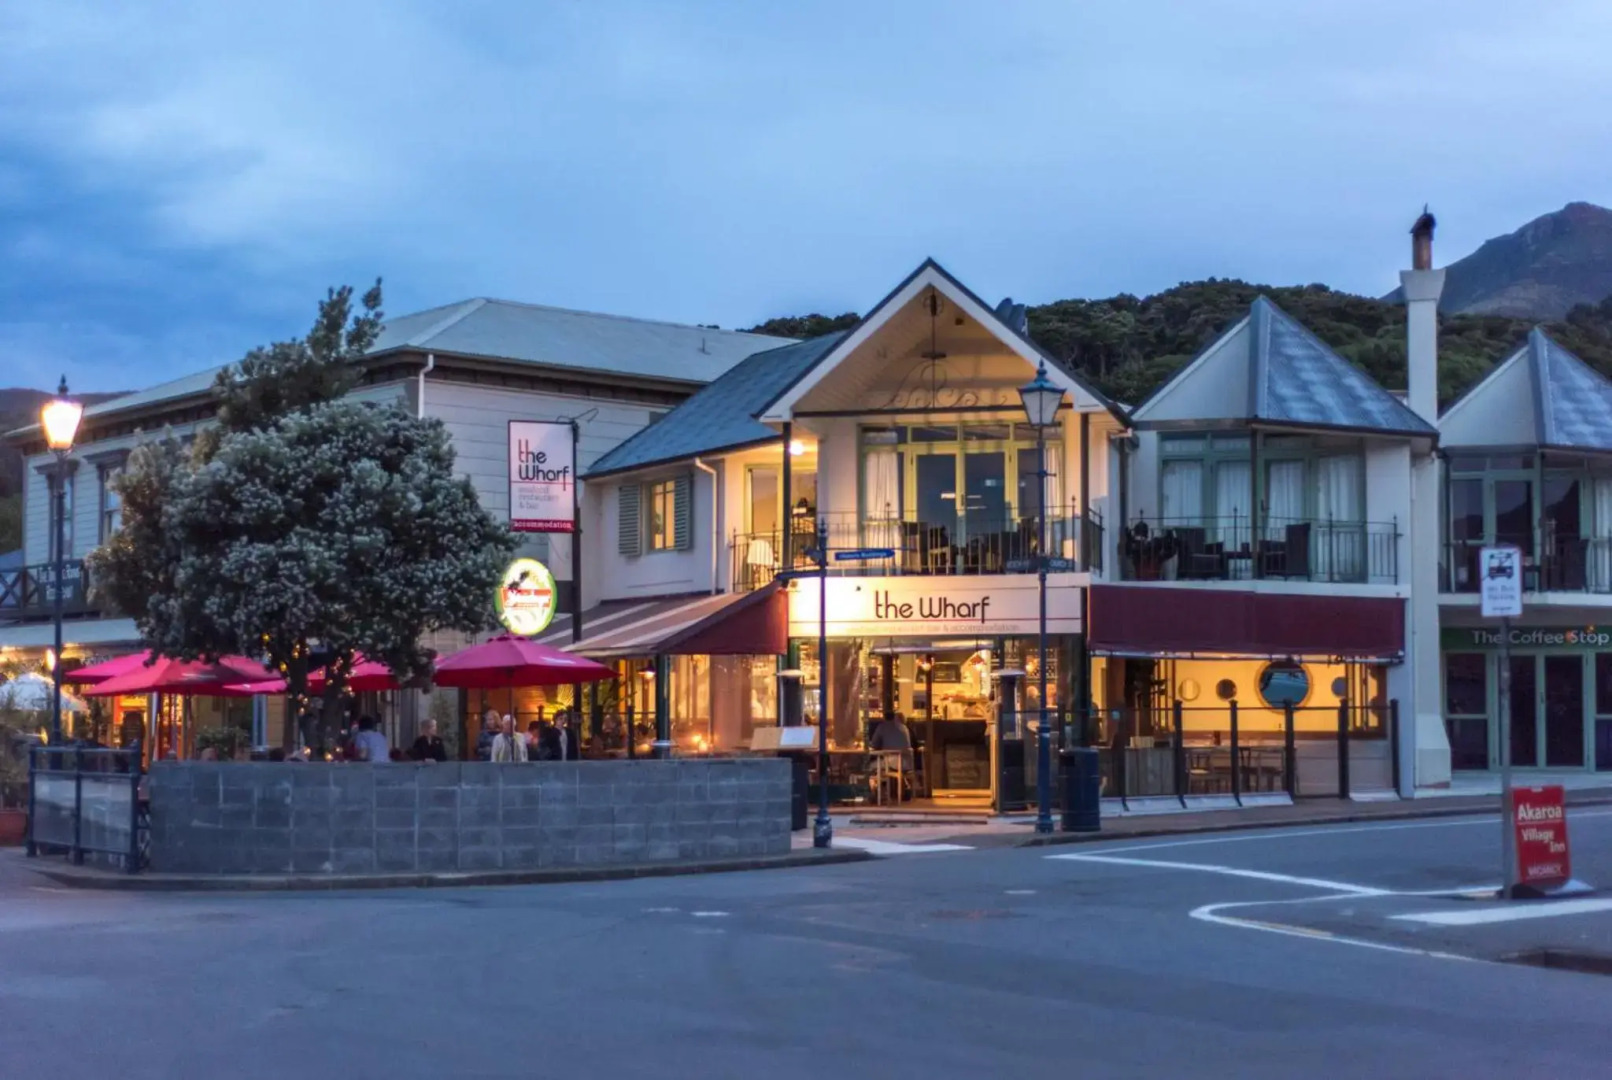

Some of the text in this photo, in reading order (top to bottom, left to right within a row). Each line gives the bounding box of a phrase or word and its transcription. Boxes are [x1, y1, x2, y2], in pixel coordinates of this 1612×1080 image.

[518, 439, 547, 464] the
[518, 464, 570, 491] Wharf
[513, 521, 573, 529] accommodation
[875, 590, 990, 624] the Wharf
[1472, 630, 1610, 646] The Coffee Stop
[1518, 804, 1563, 820] Akaroa
[1521, 828, 1555, 844] Village
[1550, 841, 1566, 854] Inn
